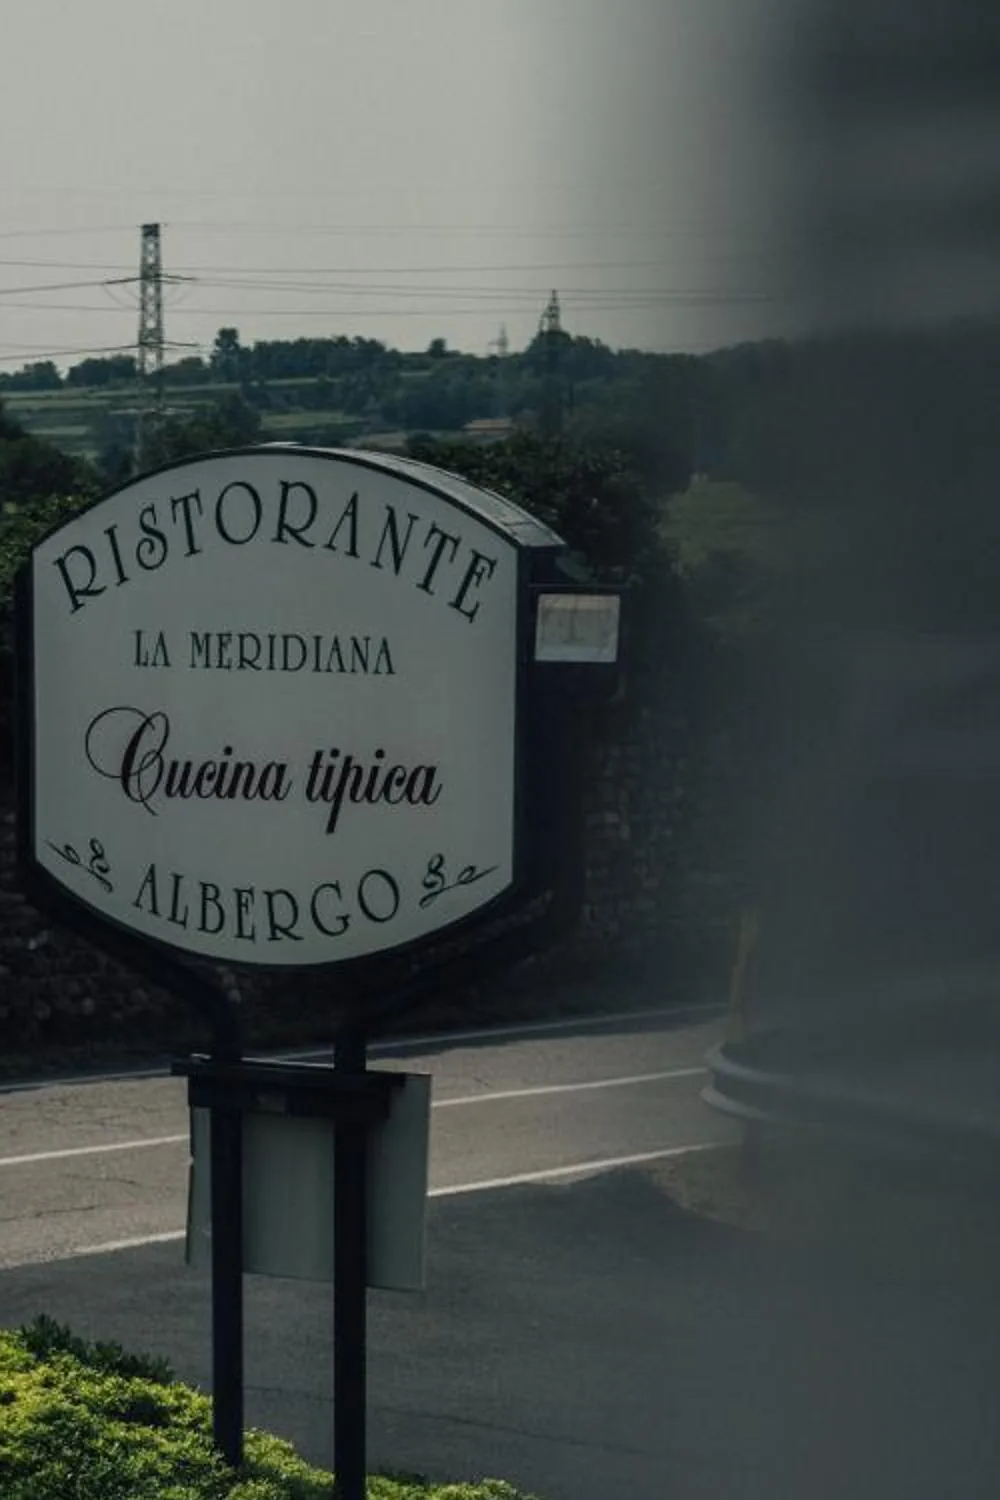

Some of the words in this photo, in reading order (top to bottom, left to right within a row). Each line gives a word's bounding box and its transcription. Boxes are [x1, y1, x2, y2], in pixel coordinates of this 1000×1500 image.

[53, 480, 497, 624] RISTORANTE
[133, 629, 171, 668] LA
[189, 631, 396, 676] MERIDIANA
[85, 706, 292, 816] Cucina
[306, 747, 443, 835] tipica
[132, 863, 401, 942] ALBERGO
